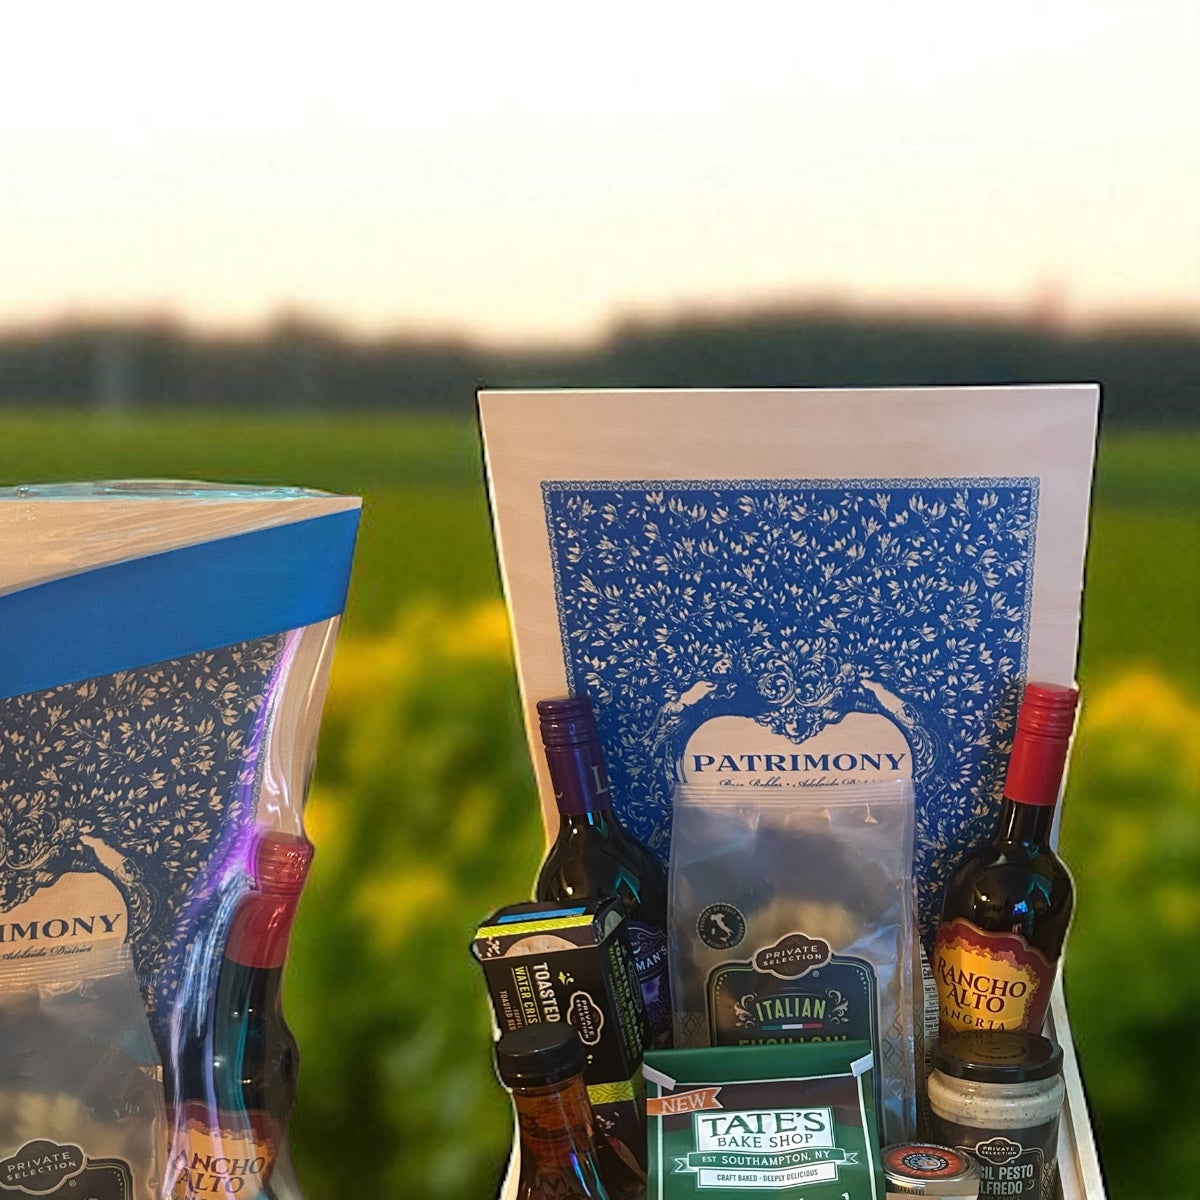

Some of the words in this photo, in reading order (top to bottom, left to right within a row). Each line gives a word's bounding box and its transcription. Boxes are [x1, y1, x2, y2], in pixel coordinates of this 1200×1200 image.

[692, 753, 906, 772] PATRIMONY
[763, 953, 823, 967] SELECTION
[766, 945, 819, 960] PRIVATE
[937, 956, 1027, 998] RANCHO
[514, 966, 532, 999] WATER
[523, 1000, 540, 1024] CRIS
[533, 962, 561, 1023] TOASTED
[946, 982, 1005, 1013] ALTO
[499, 990, 513, 1019] TOASTED
[755, 997, 827, 1022] ITALIAN
[581, 1000, 595, 1036] PRIVATE
[941, 1005, 1006, 1032] ANGRIA
[660, 1092, 707, 1114] NEW
[702, 1112, 826, 1138] TATE'S
[717, 1136, 762, 1148] BAKE
[769, 1133, 814, 1148] SHOP
[6, 1151, 72, 1173] PRIVATE
[172, 1148, 266, 1176] ANCHO
[722, 1152, 812, 1166] SOUTHAMPTON,
[815, 1150, 831, 1159] NY
[6, 1160, 77, 1182] SELECTION
[176, 1167, 245, 1195] ALTO
[716, 1174, 737, 1182] CRAFT
[738, 1173, 759, 1182] BAKED
[763, 1173, 786, 1182] DEEPLY
[786, 1168, 819, 1181] DELICIOUS
[979, 1166, 995, 1180] SIL
[999, 1164, 1034, 1180] PESTO
[980, 1181, 1023, 1196] LFREDO
